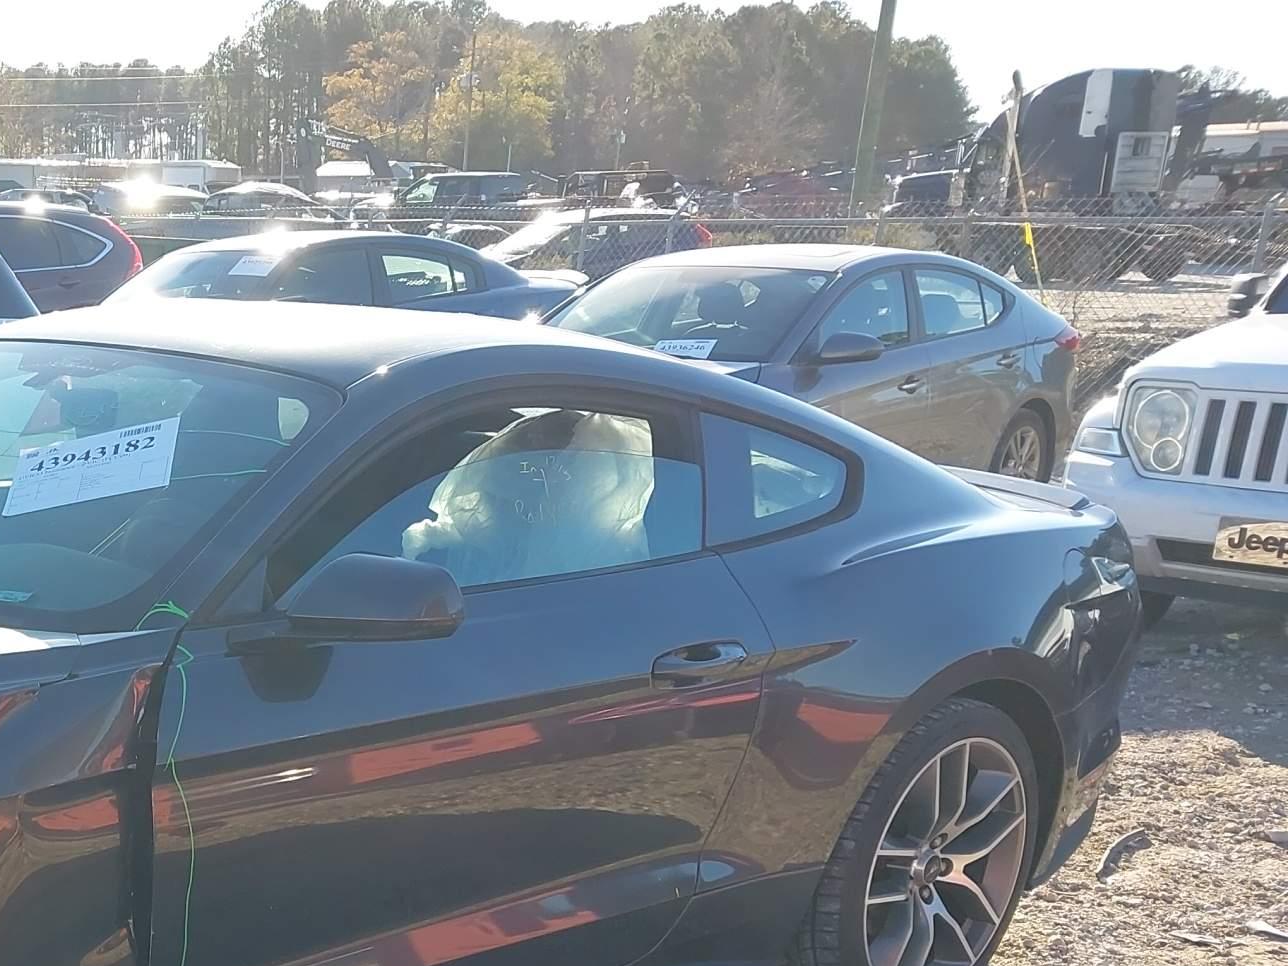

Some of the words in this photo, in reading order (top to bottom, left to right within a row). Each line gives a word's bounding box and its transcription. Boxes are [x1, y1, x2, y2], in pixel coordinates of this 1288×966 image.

[325, 138, 352, 150] DEERE
[30, 436, 155, 473] 43943182
[1227, 527, 1288, 559] Jeep
